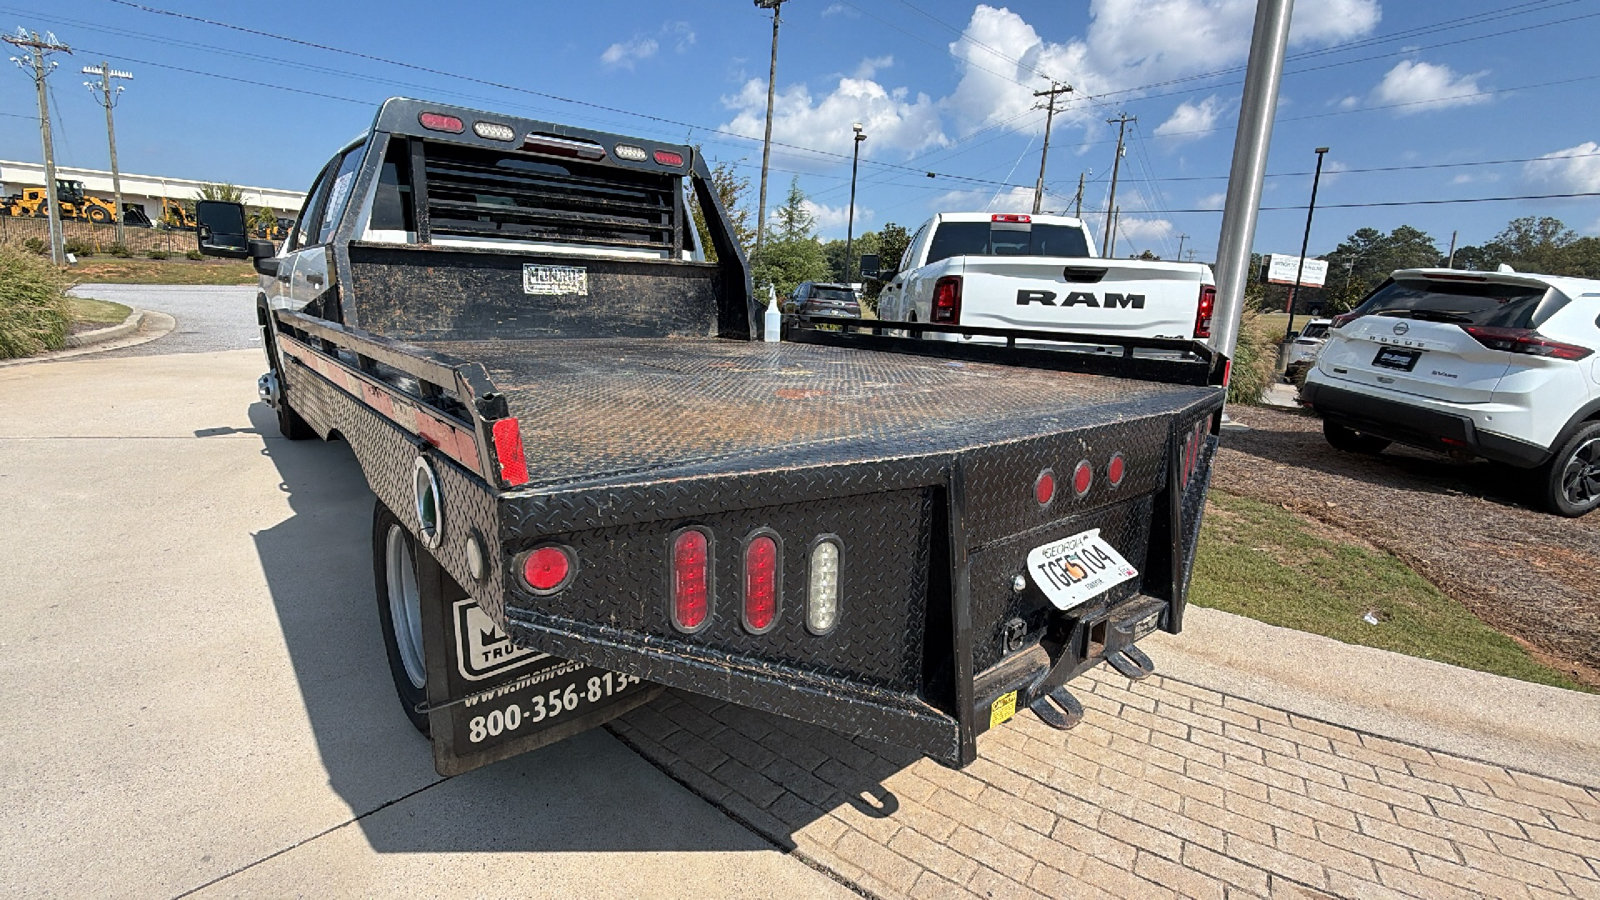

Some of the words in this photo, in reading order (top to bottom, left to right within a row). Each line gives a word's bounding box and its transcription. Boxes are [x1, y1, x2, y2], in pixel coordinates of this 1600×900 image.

[1016, 289, 1146, 309] RAM
[1369, 336, 1424, 347] ROGUE
[1042, 537, 1084, 559] GEORGIA
[1038, 544, 1116, 590] TGE5104
